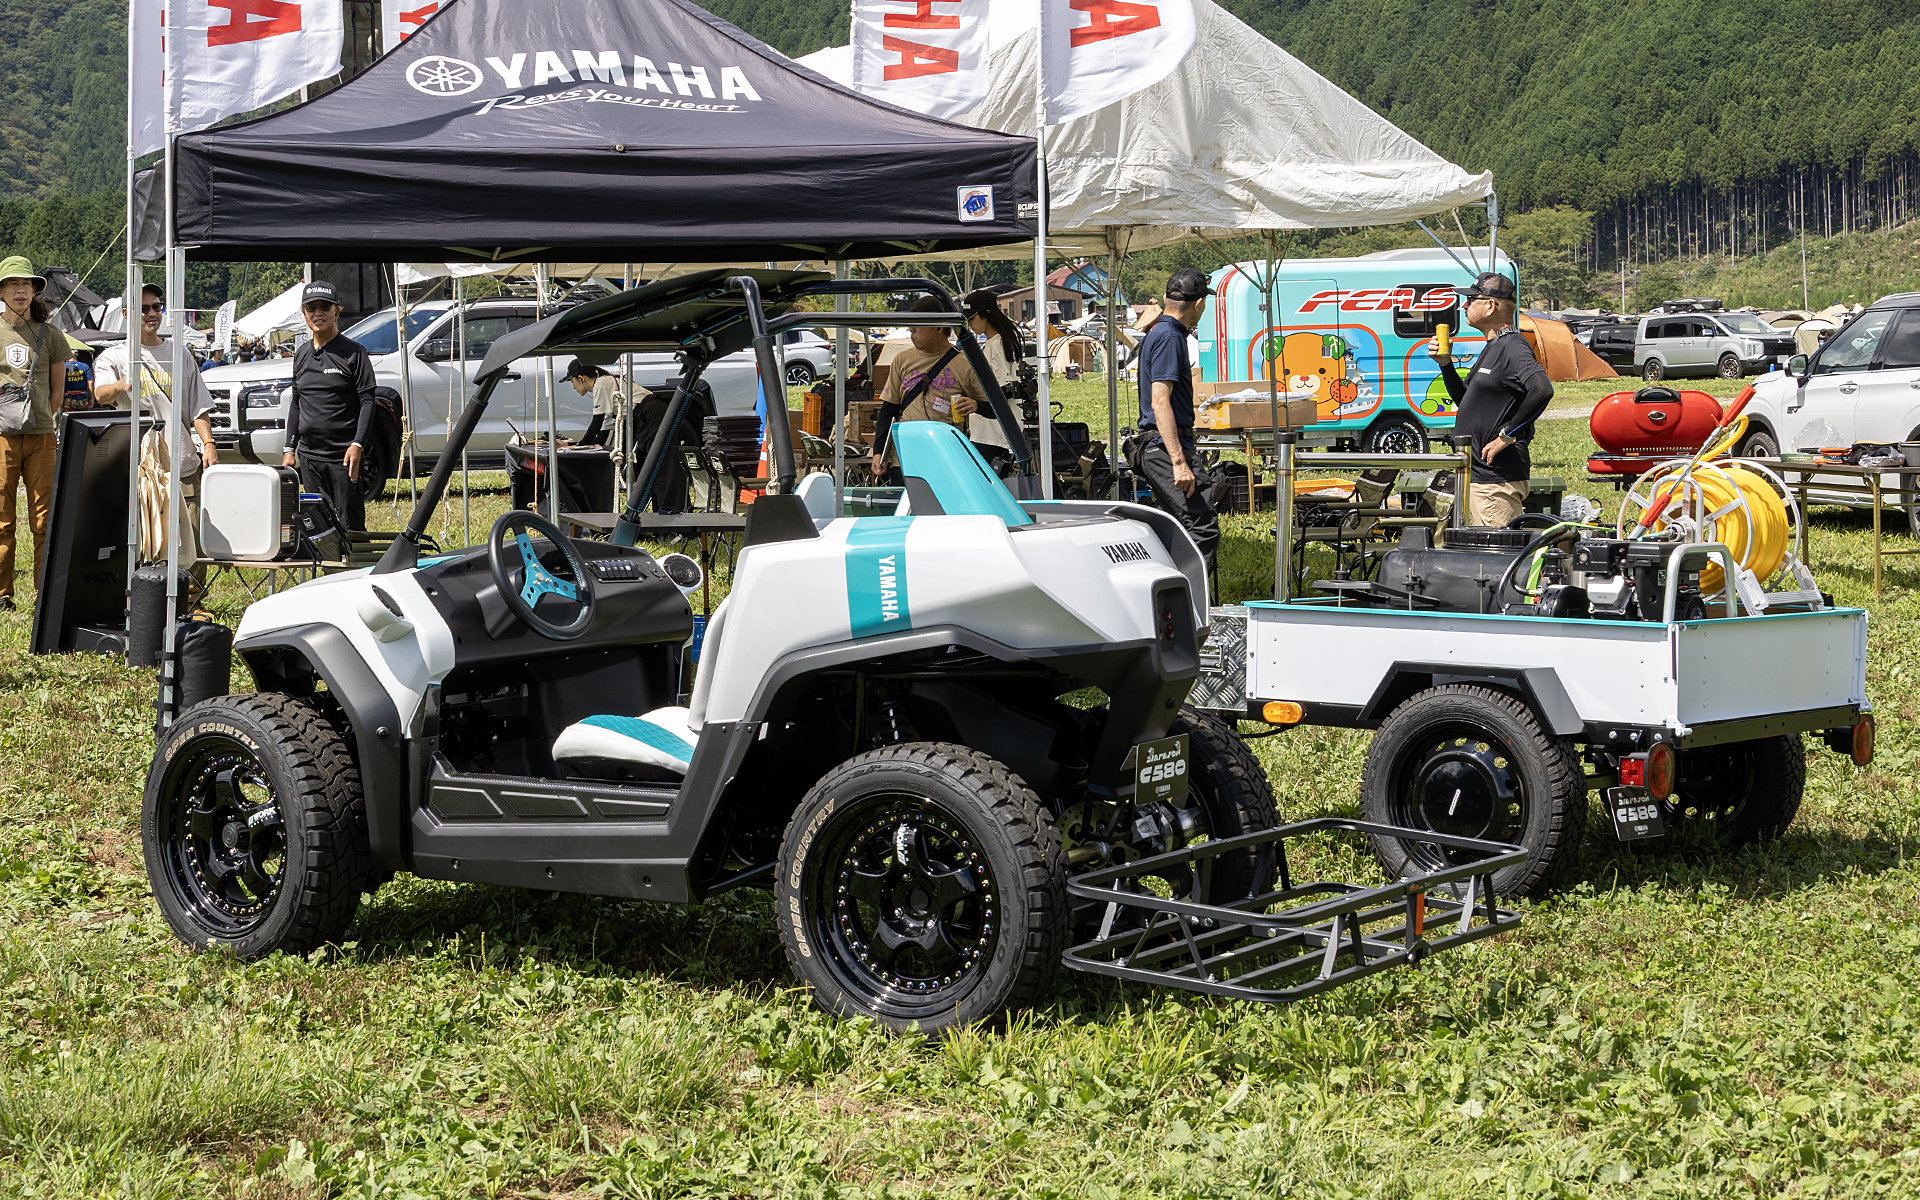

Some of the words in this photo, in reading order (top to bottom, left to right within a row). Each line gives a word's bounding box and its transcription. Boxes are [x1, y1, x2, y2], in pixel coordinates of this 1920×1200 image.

[484, 49, 762, 101] YAMAHA
[471, 89, 584, 115] Revs
[585, 88, 657, 106] Your
[658, 98, 741, 112] Heart
[1295, 287, 1467, 314] FEAS
[1101, 541, 1152, 563] YAMAHA
[878, 554, 899, 622] YAMAHA
[164, 727, 195, 762] OPEN
[198, 722, 260, 750] COUNTRY
[1140, 759, 1185, 783] C580
[254, 806, 277, 821] WORK
[1617, 805, 1657, 822] C580
[789, 797, 835, 890] COUNTRY
[789, 896, 812, 958] OPEN
